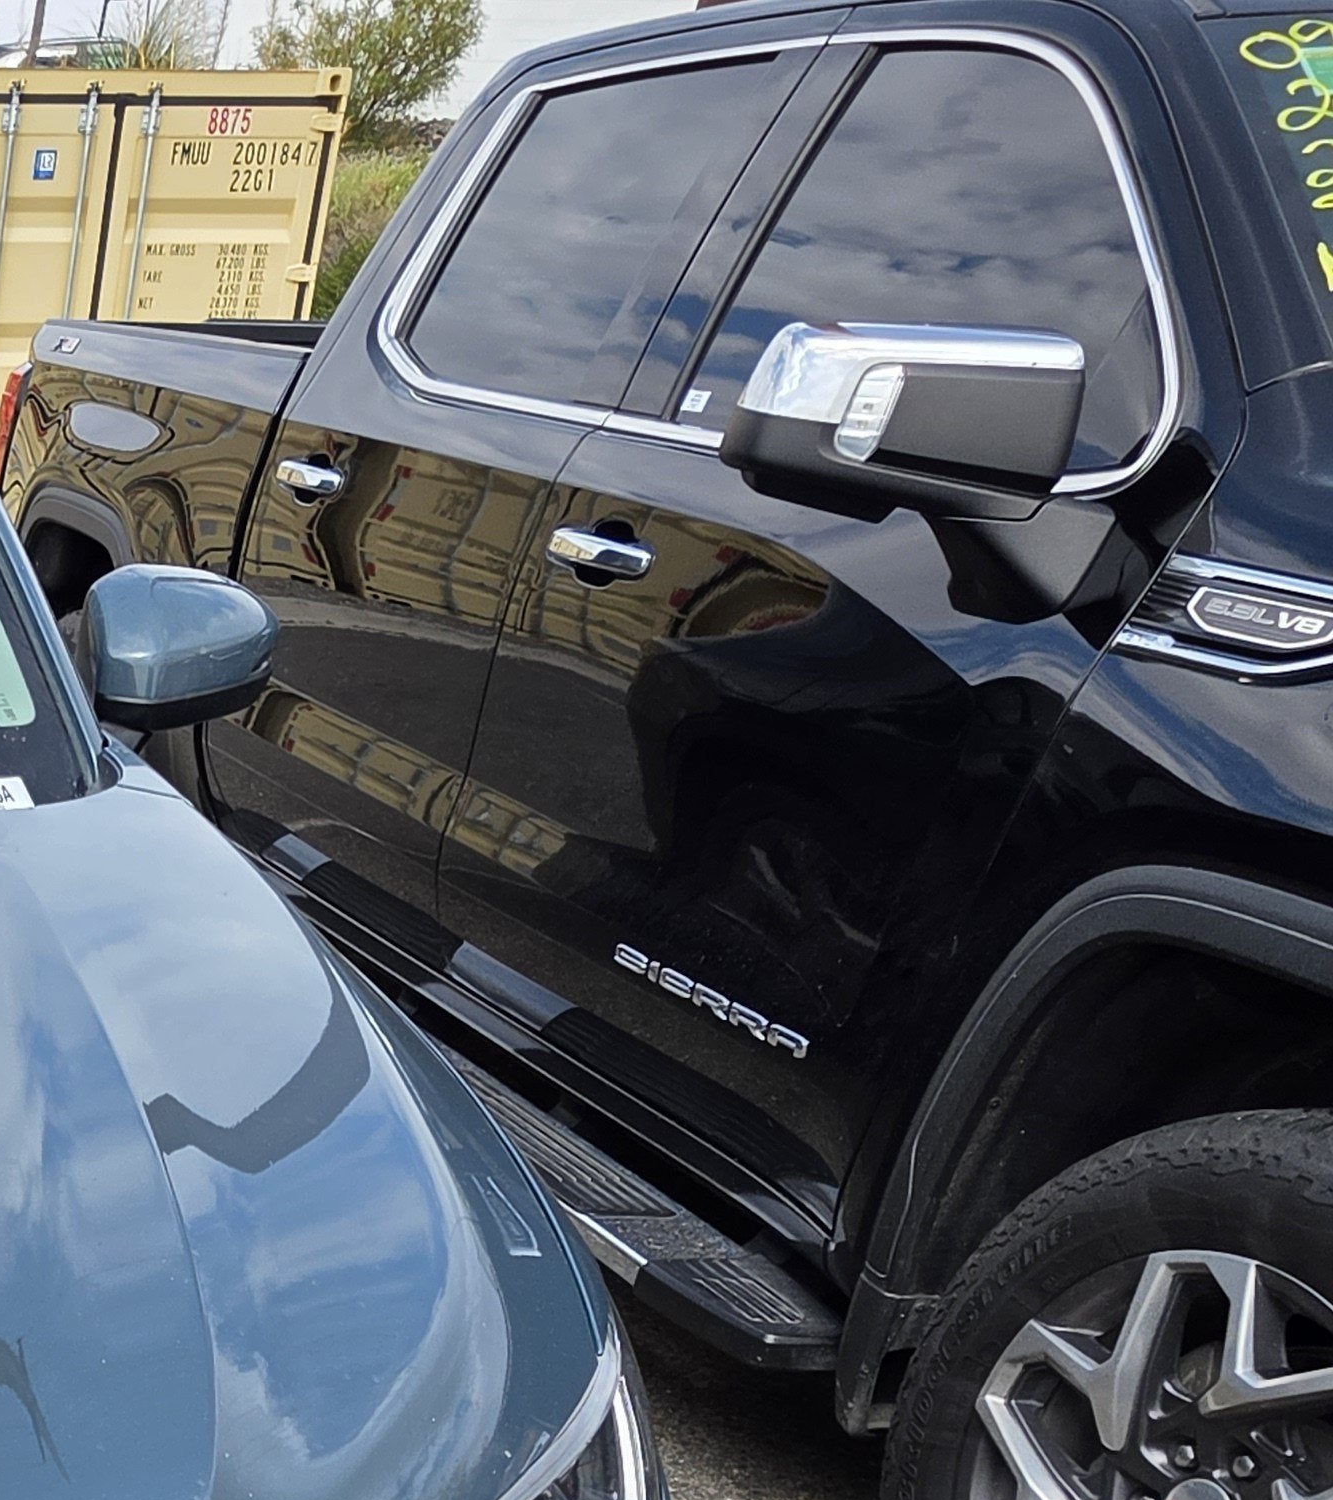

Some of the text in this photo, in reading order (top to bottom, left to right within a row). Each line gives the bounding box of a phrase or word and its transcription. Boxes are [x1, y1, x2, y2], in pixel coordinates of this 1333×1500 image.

[171, 141, 211, 166] FMUU
[229, 168, 274, 192] 22G1
[142, 270, 163, 283] TARE
[613, 942, 811, 1060] SIERRA
